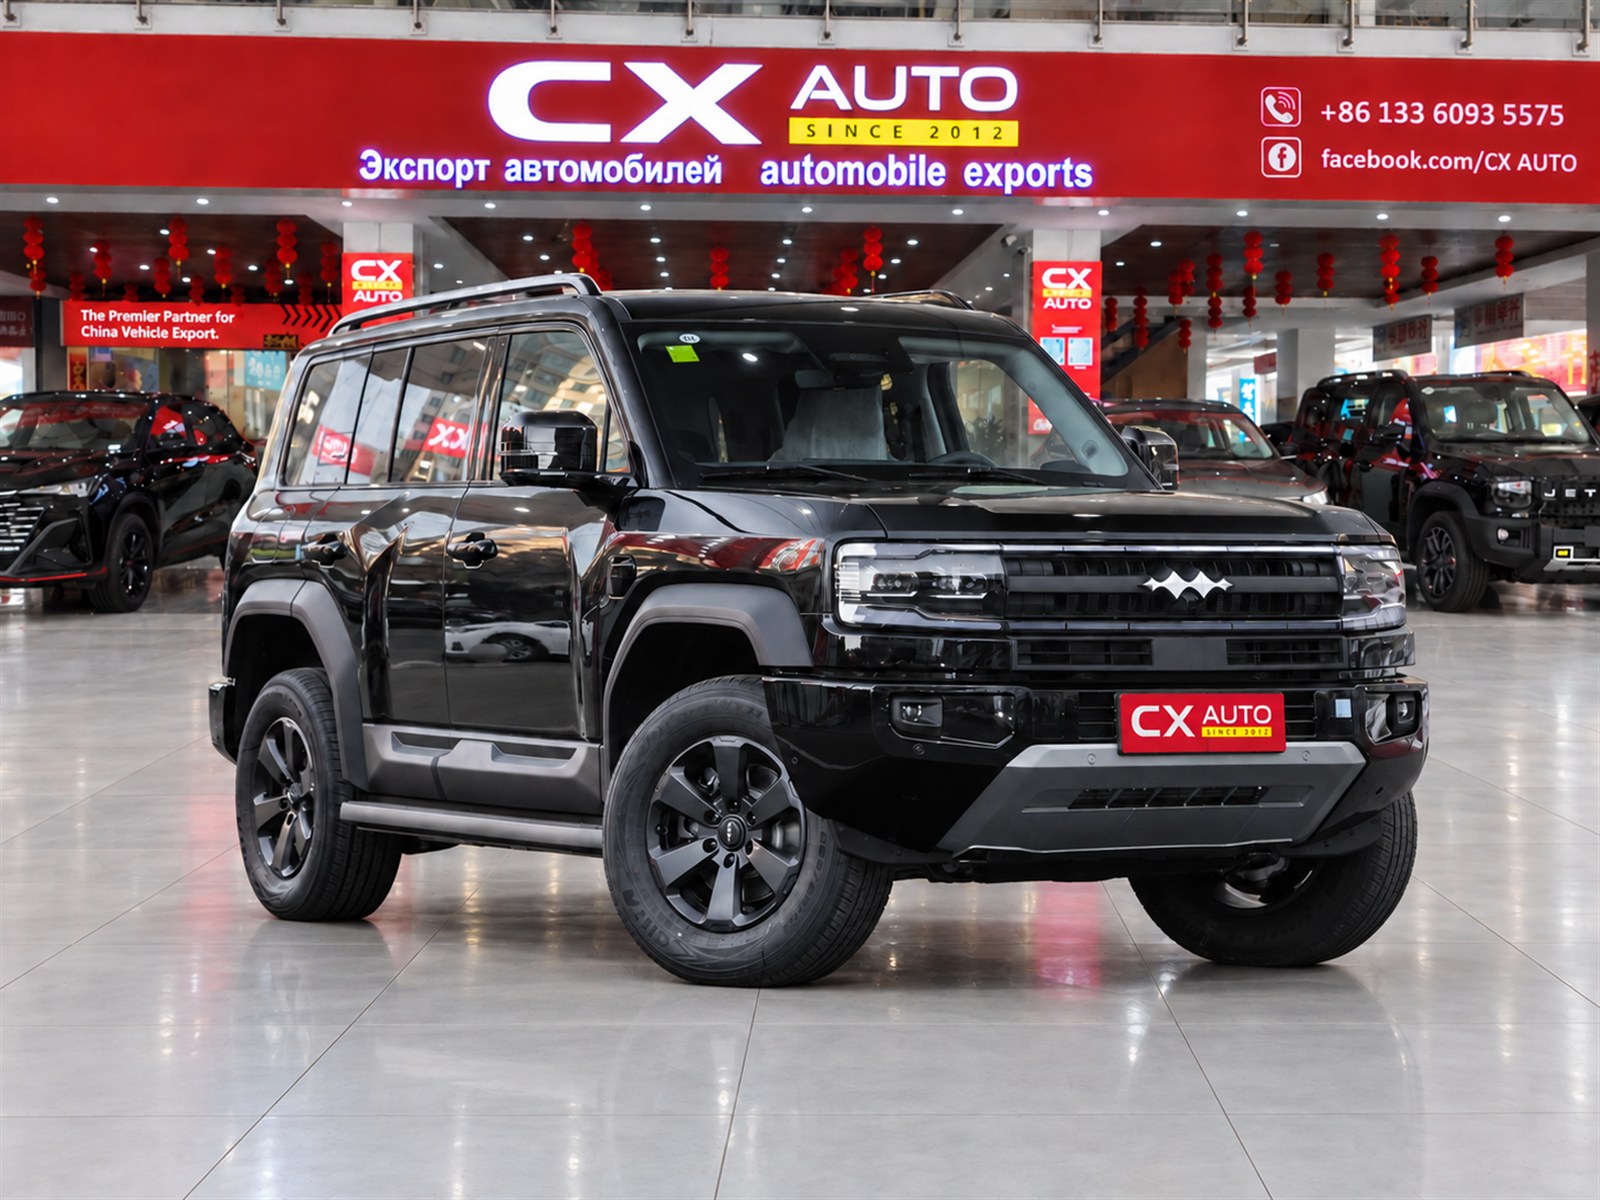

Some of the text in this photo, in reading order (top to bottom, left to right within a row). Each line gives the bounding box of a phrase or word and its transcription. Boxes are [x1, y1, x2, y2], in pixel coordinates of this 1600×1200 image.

[488, 60, 1019, 145] CX AUTO
[1321, 100, 1564, 127] +86 133 6093 5575
[806, 123, 1003, 140] SINCE 2012
[359, 149, 722, 188] Экспорт автомобилей
[1321, 148, 1578, 174] facebook.com/CX AUTO
[761, 154, 1093, 195] automobile exports
[351, 259, 402, 282] CX
[1042, 267, 1092, 290] CX
[352, 290, 403, 303] AUTO
[1043, 298, 1092, 310] AUTO
[80, 309, 235, 323] The Premier Partner for
[80, 325, 219, 342] China Vehicle Export.
[1131, 704, 1272, 738] CX AUTO
